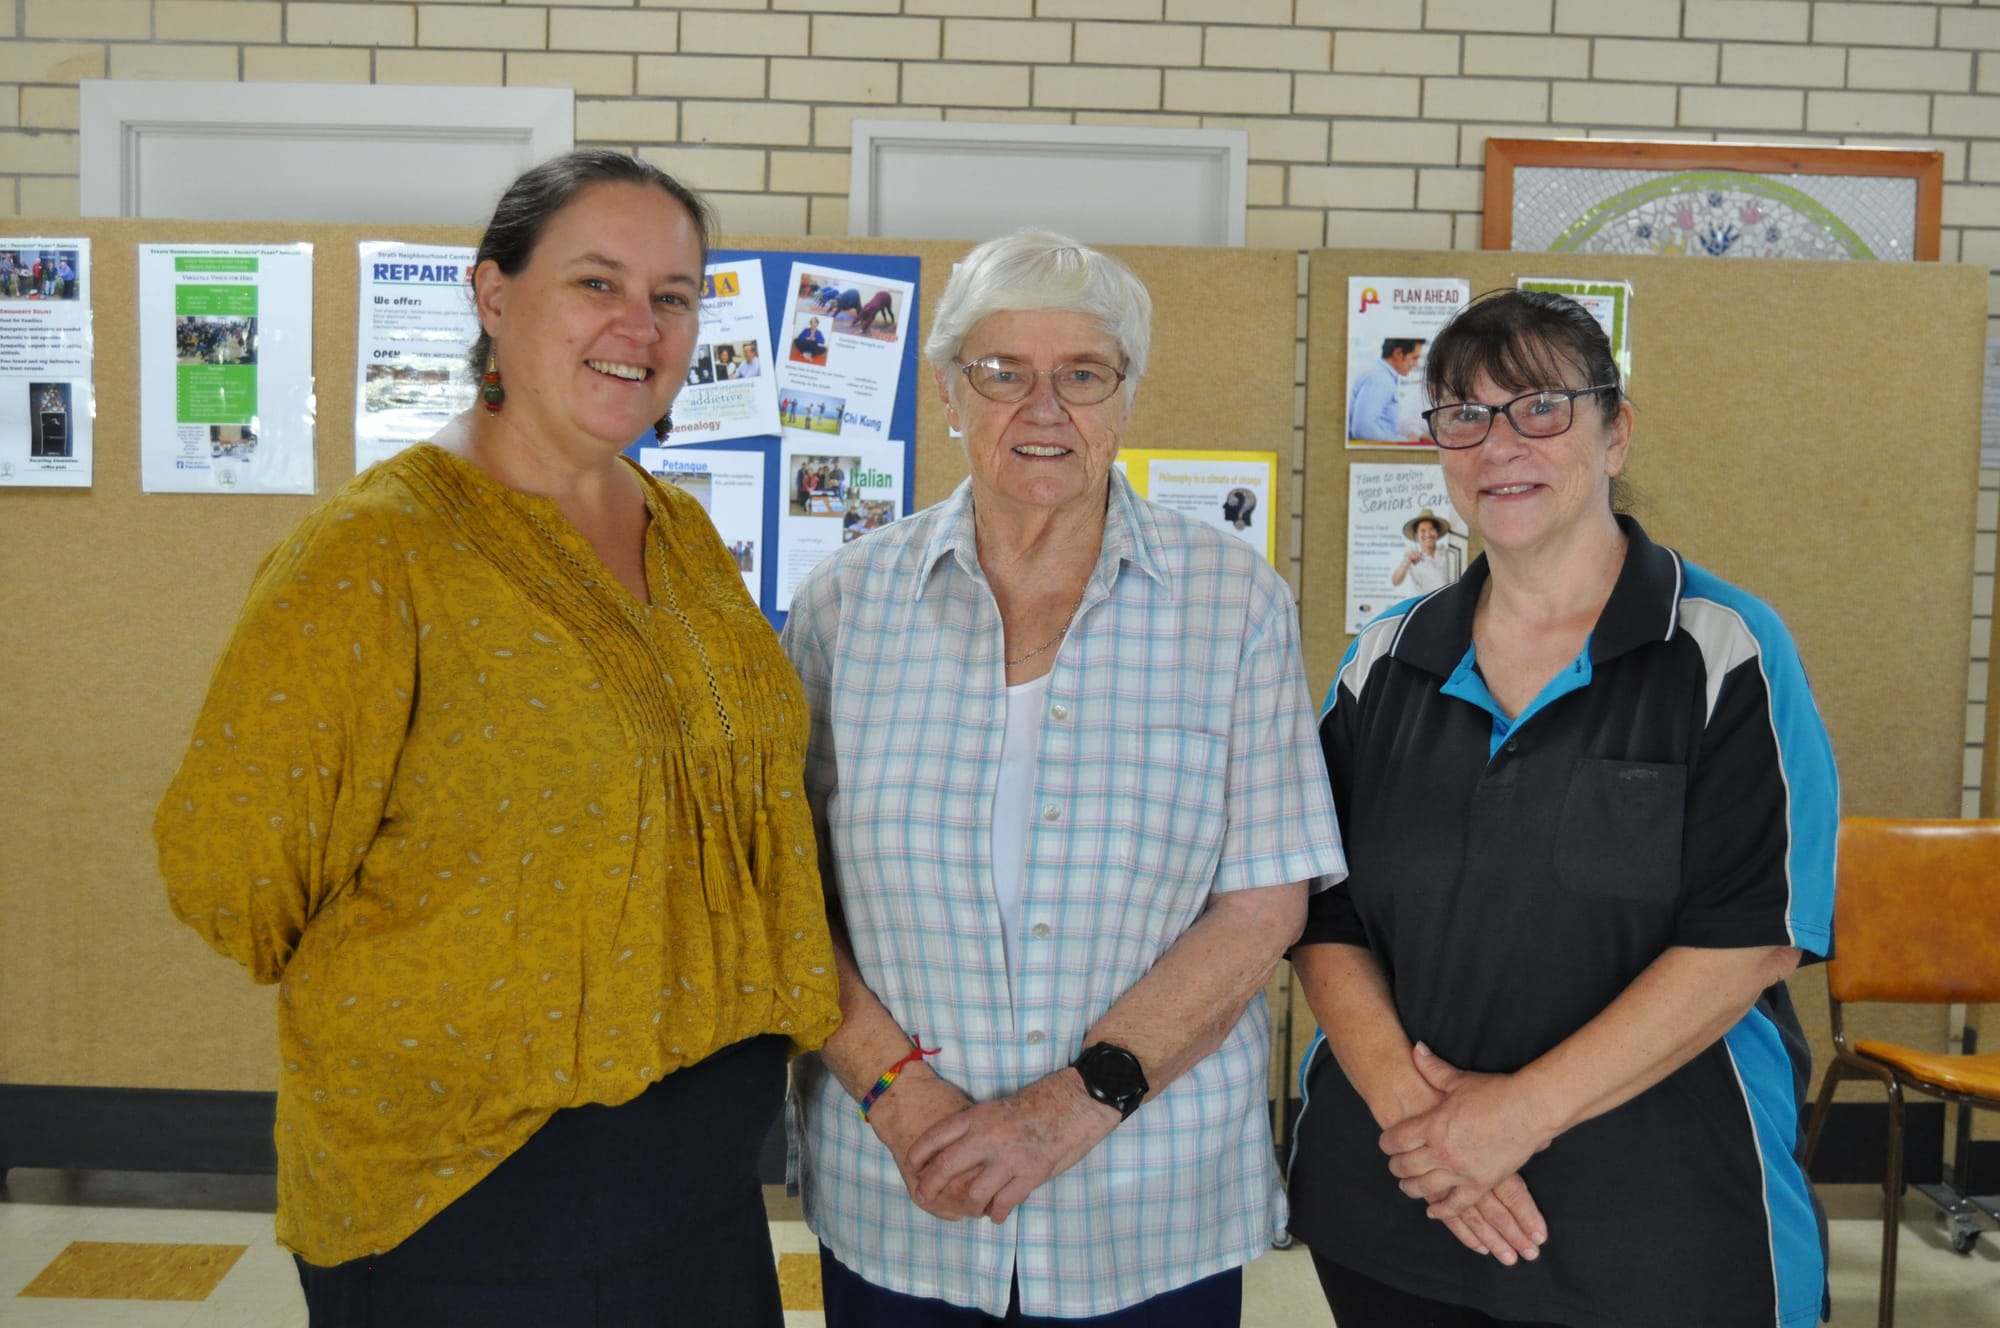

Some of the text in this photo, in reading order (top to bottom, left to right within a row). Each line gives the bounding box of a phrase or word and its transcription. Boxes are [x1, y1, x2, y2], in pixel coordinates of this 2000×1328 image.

[398, 252, 448, 261] Neighbourhood
[373, 263, 458, 282] REPAIR
[374, 296, 422, 306] We offer:
[1393, 288, 1459, 304] PLAN AHEAD
[373, 350, 400, 358] OPEN
[690, 391, 743, 407] addictive
[843, 411, 882, 431] Chi Kung
[662, 459, 708, 472] Petanque
[849, 467, 893, 488] Italian
[1158, 471, 1192, 486] Philosophy
[1355, 469, 1424, 485] Time to enjoy
[1385, 483, 1409, 497] with
[1411, 482, 1435, 495] your
[1360, 496, 1413, 514] Seniors
